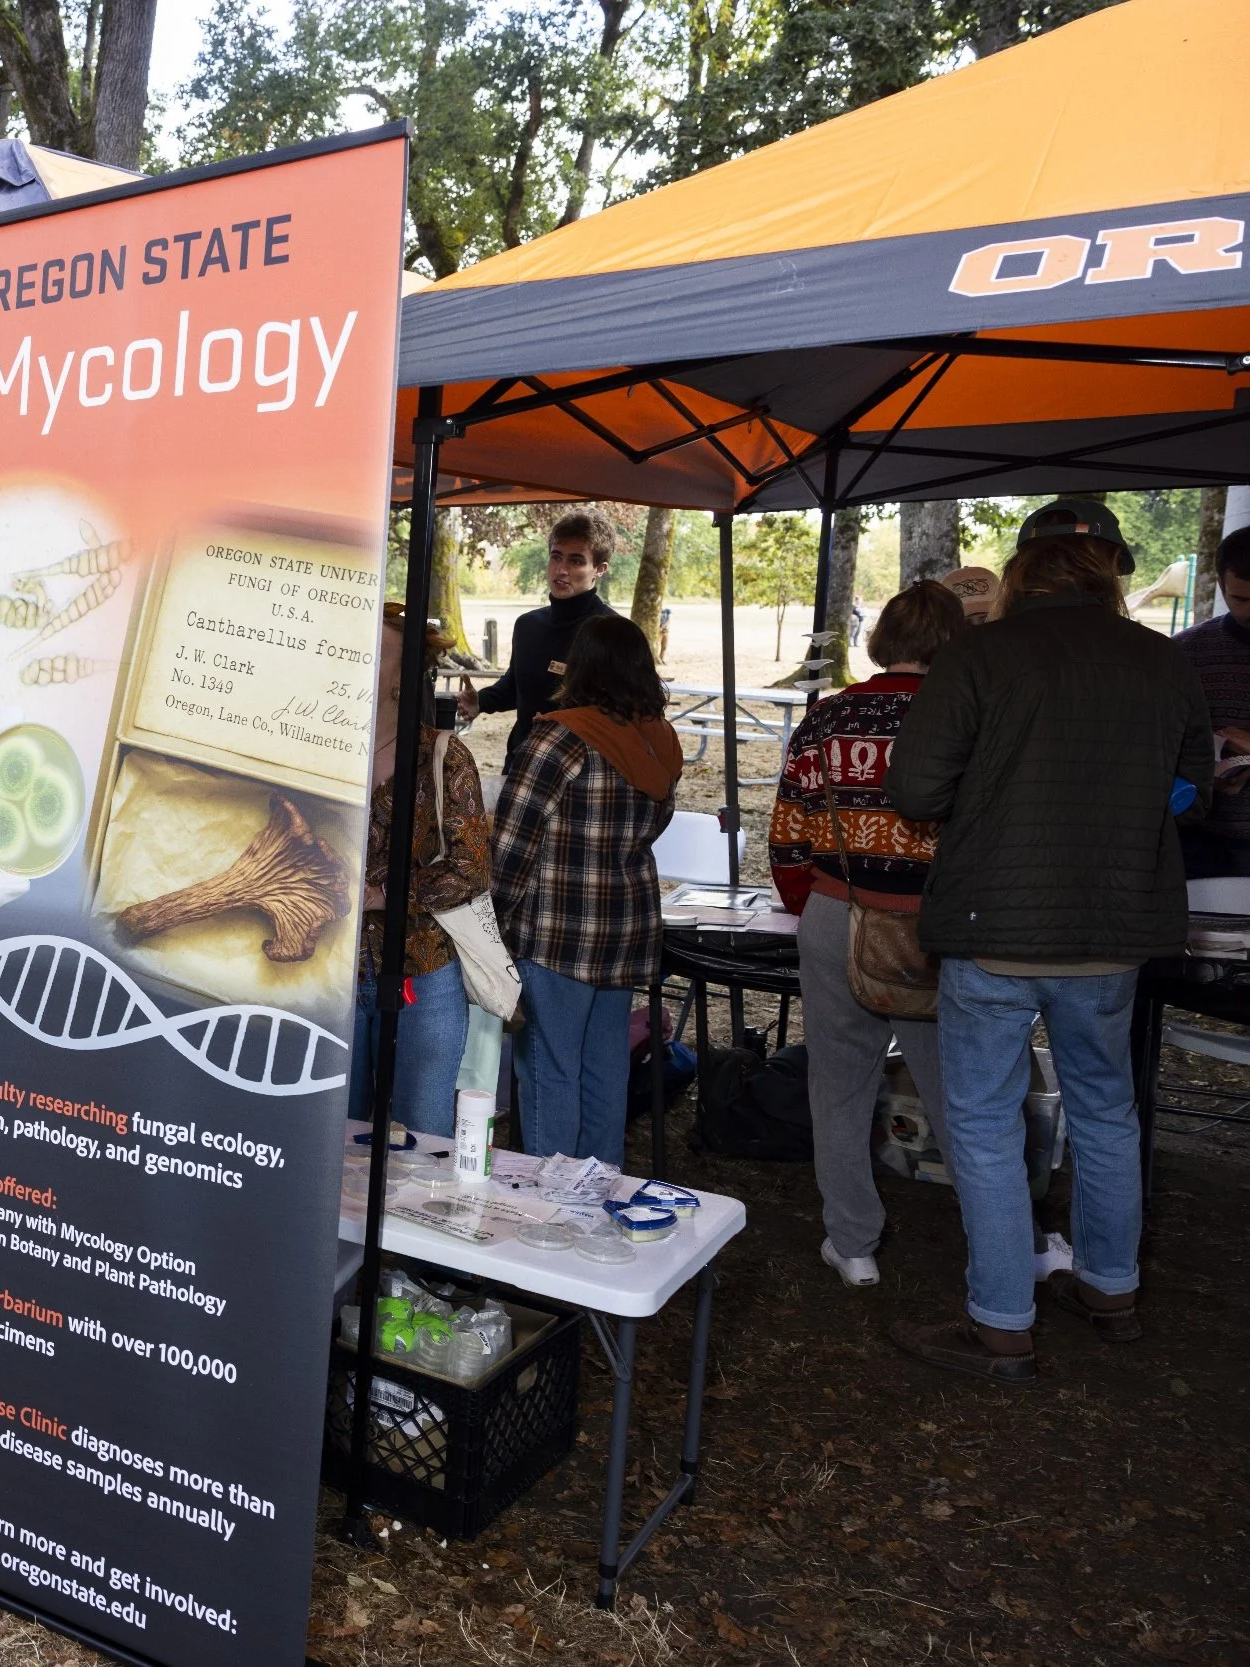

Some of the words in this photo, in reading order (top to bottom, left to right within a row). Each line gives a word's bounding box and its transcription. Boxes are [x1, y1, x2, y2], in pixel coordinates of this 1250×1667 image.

[141, 213, 292, 286] STATE
[948, 216, 1245, 297] OR
[206, 545, 262, 566] OREGON
[269, 556, 314, 575] STATE
[320, 564, 378, 587] UNIVER
[228, 573, 273, 592] FUNGI
[280, 583, 301, 598] OF
[307, 588, 375, 612] OREGON
[186, 611, 307, 651] Cantharellus
[315, 639, 373, 665] formo
[271, 603, 314, 623] U.S.A.
[170, 668, 194, 686] No.
[200, 675, 234, 695] 1349
[176, 646, 188, 661] J.
[194, 649, 206, 665] W.
[213, 654, 255, 676] Clark
[165, 694, 213, 721] Oregon,
[218, 706, 248, 727] Lane
[252, 715, 274, 736] Co.,
[279, 722, 354, 753] Willamette
[13, 1119, 101, 1159] pathology,
[106, 1141, 140, 1166] and
[145, 1151, 243, 1189] genomics
[29, 1092, 128, 1135] researching
[132, 1112, 195, 1146] fungal
[201, 1131, 285, 1168] ecology,
[10, 1235, 59, 1267] Botany
[63, 1251, 91, 1274] and
[95, 1260, 134, 1287] Plant
[139, 1272, 226, 1316] Pathology
[26, 1212, 56, 1236] with
[60, 1222, 133, 1262] Mycology
[137, 1246, 196, 1275] Option
[67, 1315, 106, 1344] with
[111, 1333, 154, 1359] over
[159, 1343, 237, 1384] 100,000
[0, 1429, 62, 1471] disease
[66, 1460, 142, 1503] samples
[147, 1491, 236, 1542] annually
[20, 1407, 67, 1441] Clinic
[71, 1426, 164, 1478] diagnoses
[169, 1464, 223, 1499] more
[229, 1483, 276, 1520] than
[20, 1529, 66, 1561] more
[70, 1546, 105, 1578] and
[110, 1565, 139, 1594] get
[145, 1577, 237, 1635] involved:
